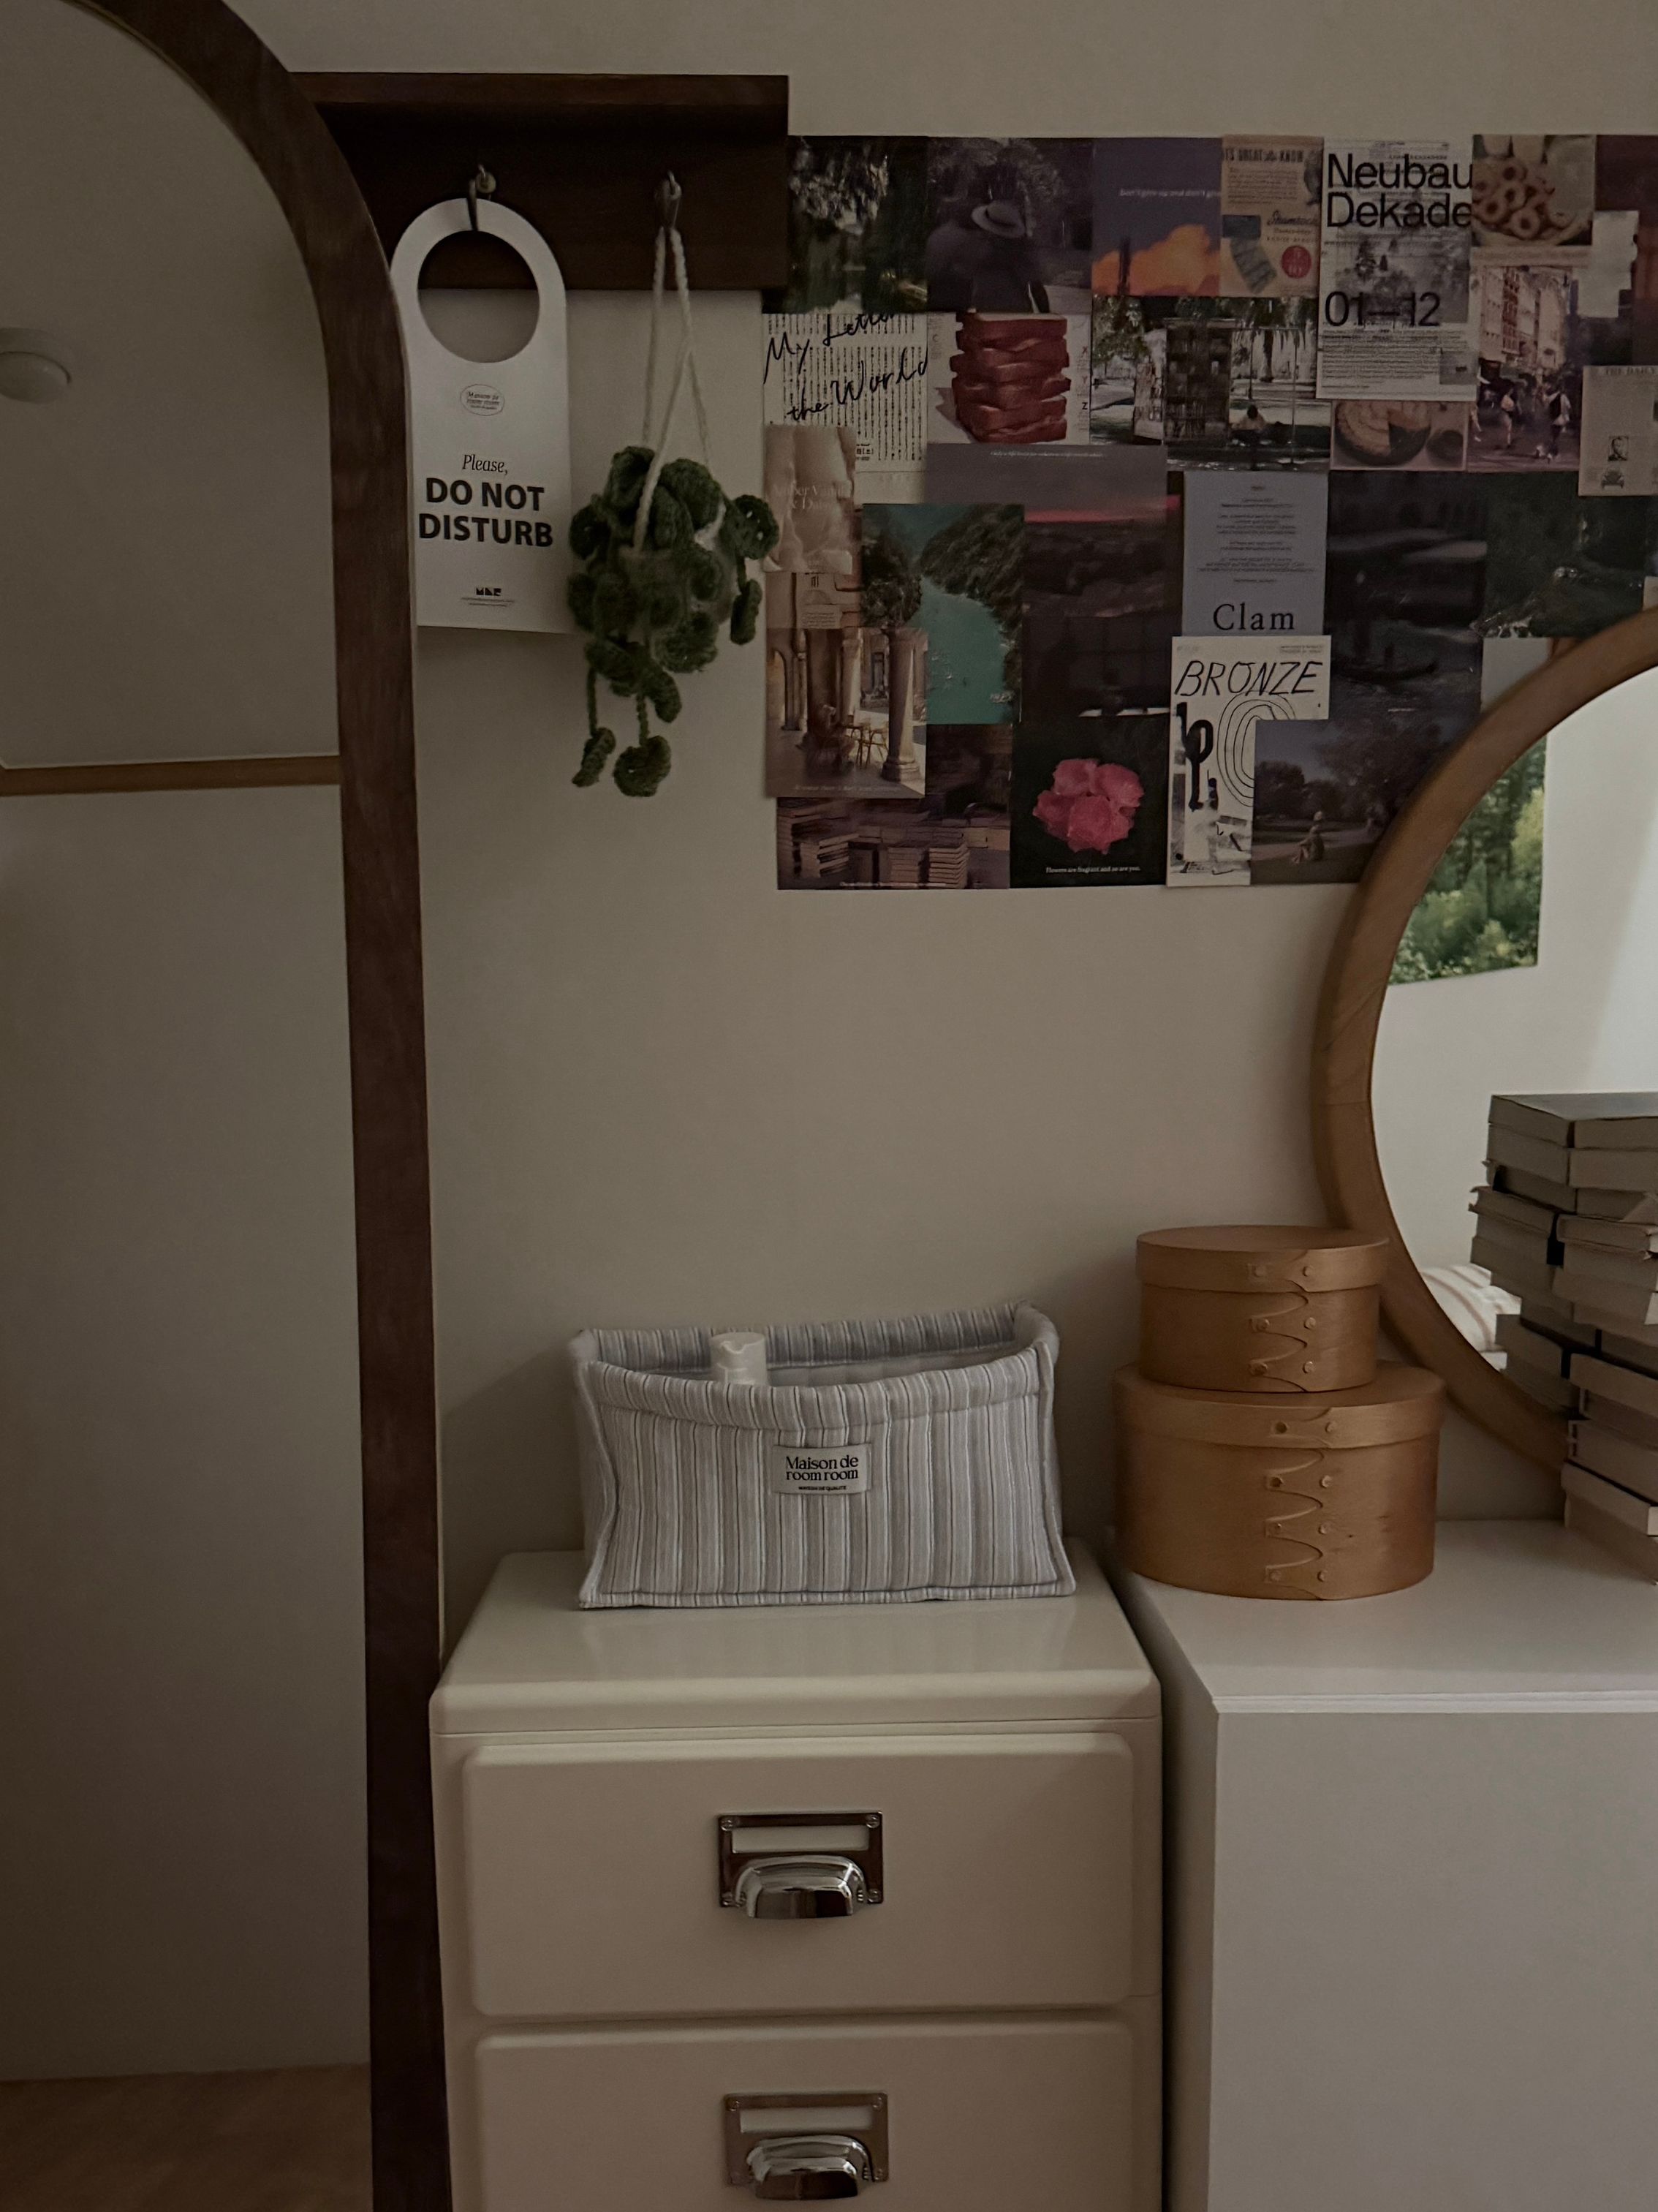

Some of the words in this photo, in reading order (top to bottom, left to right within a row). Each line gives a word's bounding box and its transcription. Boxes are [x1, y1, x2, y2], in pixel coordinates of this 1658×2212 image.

[1328, 153, 1473, 189] Neubau
[1327, 192, 1472, 228] Dekade
[762, 332, 810, 385] My
[787, 388, 828, 420] the
[830, 347, 928, 405] World
[461, 454, 509, 475] Please,
[425, 477, 474, 505] DO
[481, 482, 545, 511] NOT
[419, 513, 553, 547] DISTURB
[1213, 602, 1295, 630] Clam
[1174, 660, 1322, 696] BRONZE
[786, 1455, 838, 1470] Maison
[840, 1454, 859, 1468] de
[786, 1470, 822, 1481] room
[824, 1469, 858, 1481] room
